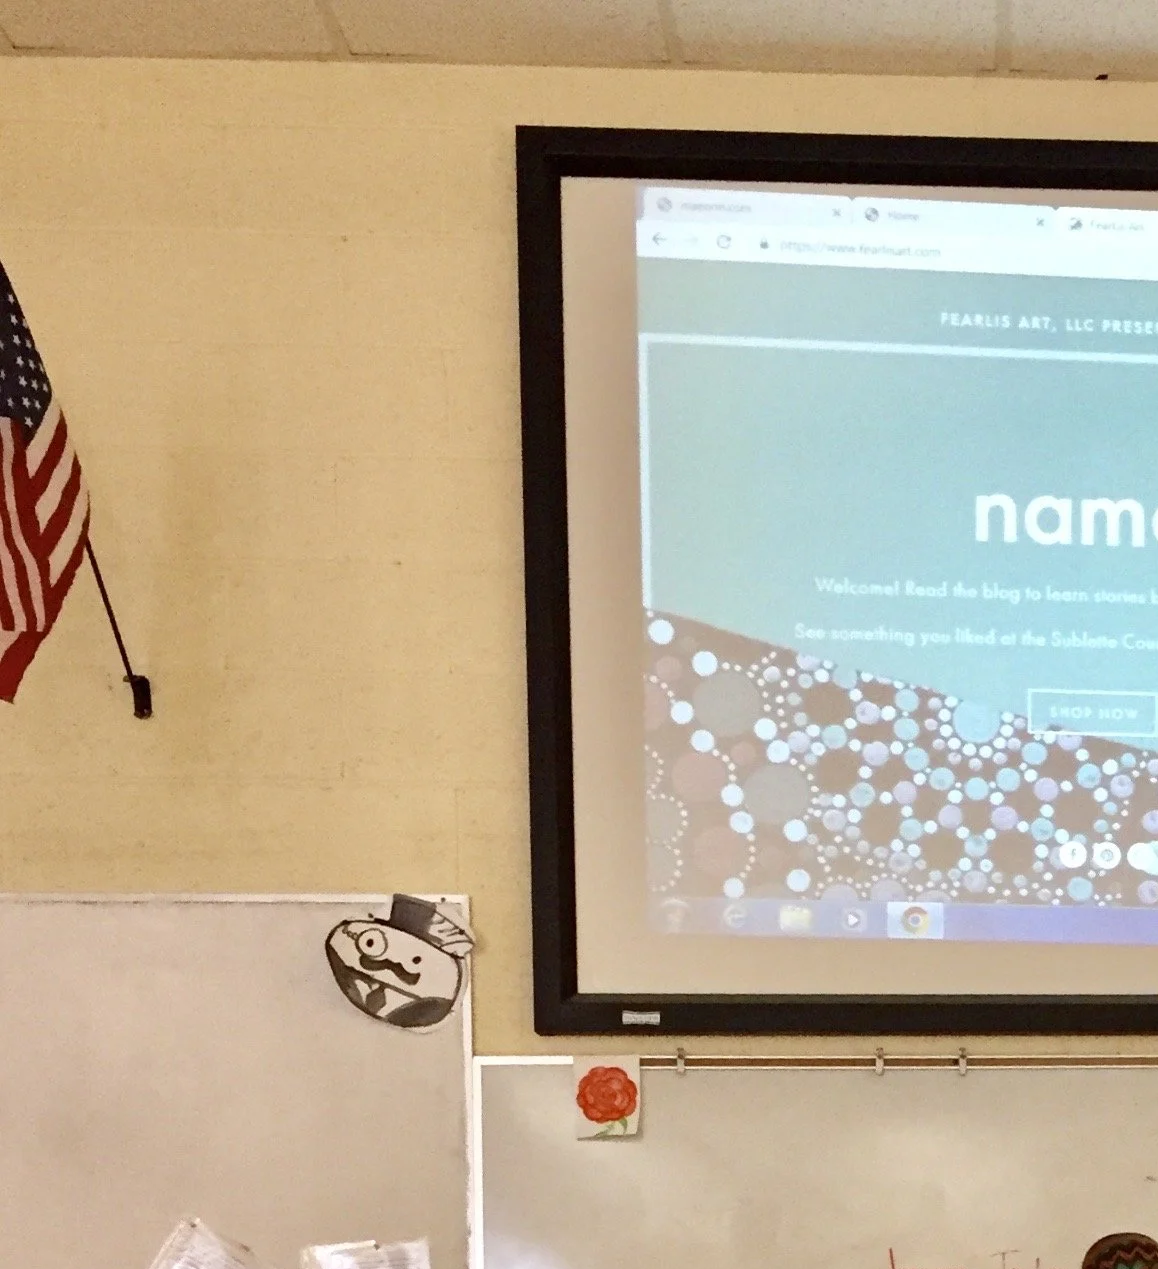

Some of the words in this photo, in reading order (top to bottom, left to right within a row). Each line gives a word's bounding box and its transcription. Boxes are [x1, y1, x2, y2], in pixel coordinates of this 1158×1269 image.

[940, 312, 1010, 328] FEARLIS
[1018, 316, 1058, 332] ART,
[1065, 318, 1094, 332] LLC
[814, 576, 899, 596] Welcome!
[905, 581, 948, 598] Read
[953, 583, 978, 599] the
[982, 583, 1020, 605] blog
[1025, 586, 1041, 601] to
[1046, 585, 1087, 602] learn
[1094, 587, 1146, 605] stories
[795, 623, 826, 641] See
[830, 625, 915, 647] something
[920, 632, 950, 648] you
[955, 628, 997, 646] liked
[1000, 632, 1017, 646] at
[1022, 630, 1046, 647] the
[1051, 631, 1118, 650] Sublette
[1050, 705, 1092, 721] SHOP
[1100, 706, 1138, 721] NOW
